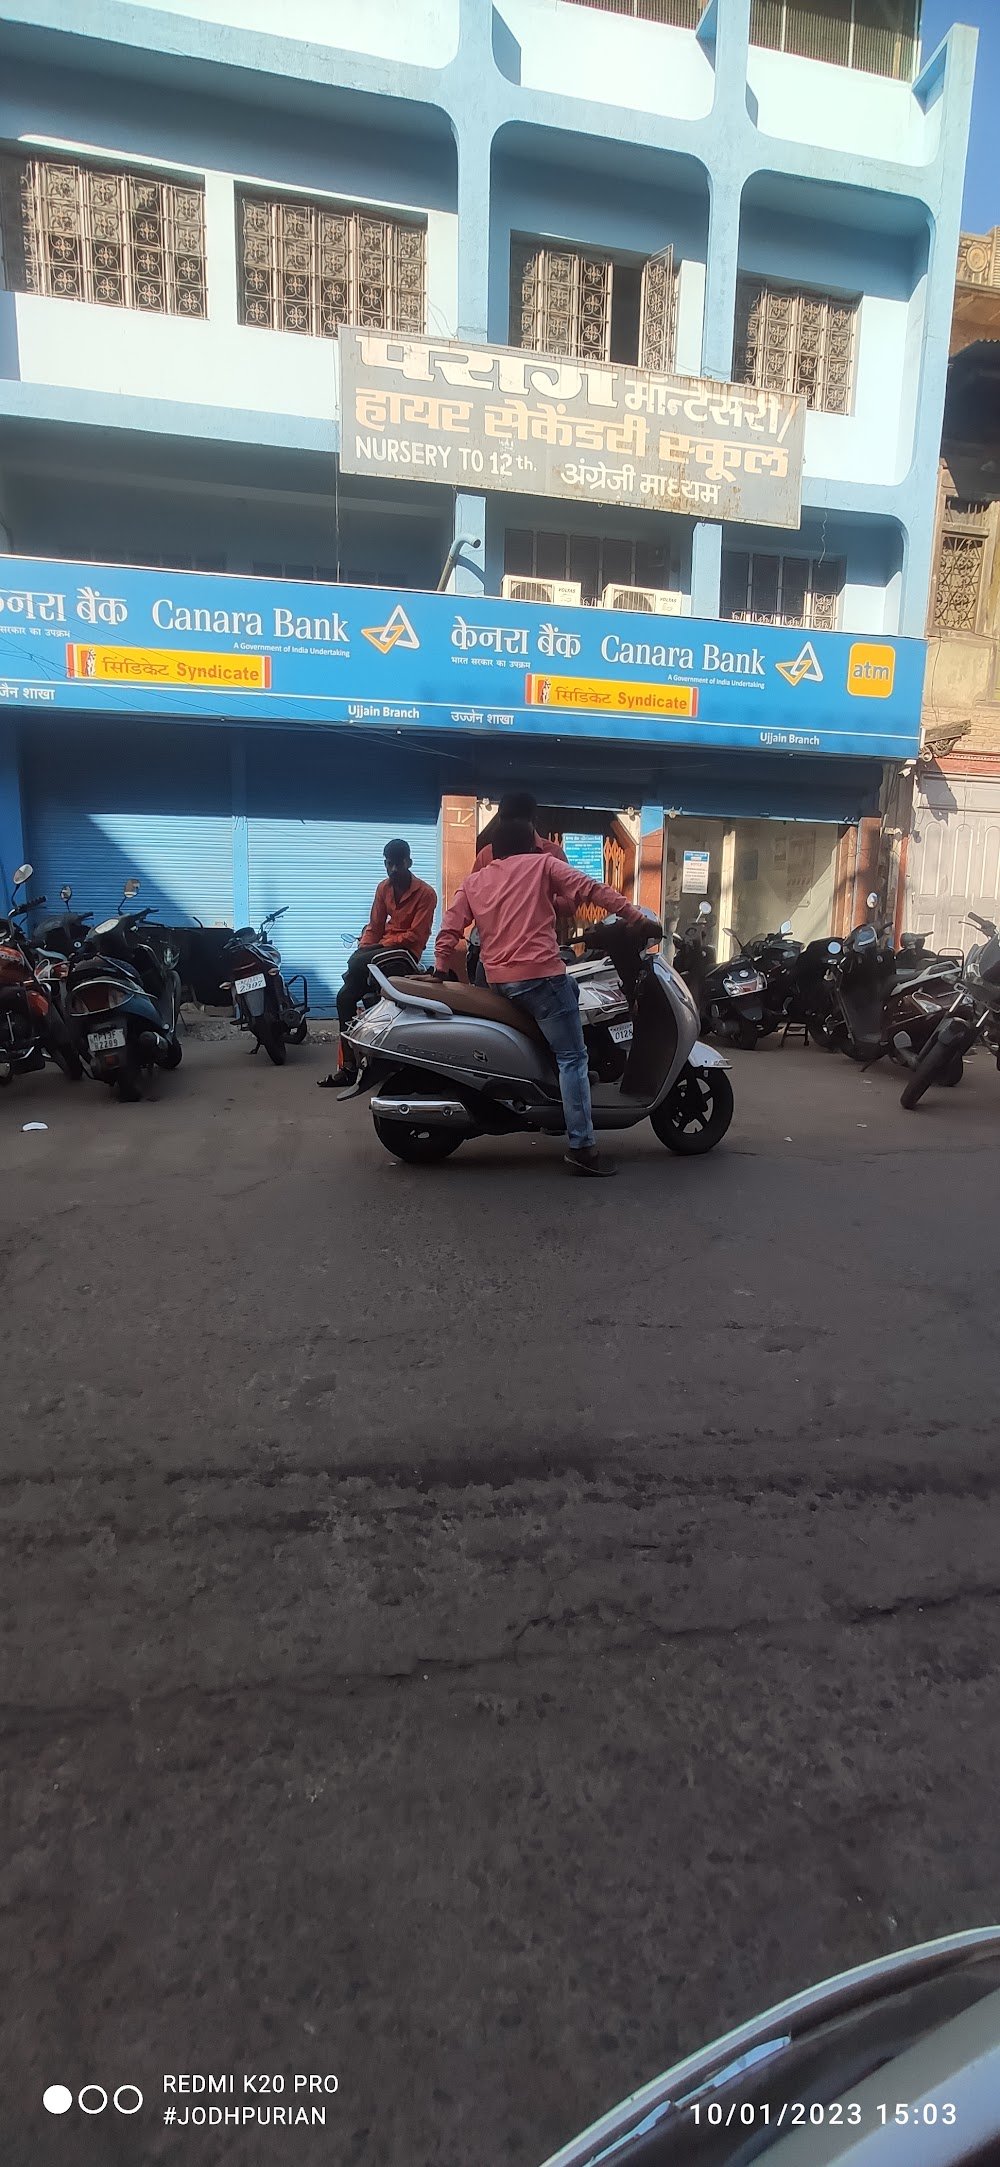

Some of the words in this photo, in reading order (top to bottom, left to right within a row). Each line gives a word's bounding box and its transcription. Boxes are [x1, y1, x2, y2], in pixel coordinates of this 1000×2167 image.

[355, 335, 618, 408] पराग
[355, 388, 473, 432] हायर
[484, 398, 650, 457] सेकेंडरी
[659, 430, 789, 483] स्कूल
[355, 435, 452, 469] NURSERY
[458, 447, 484, 474] TO
[560, 457, 636, 493] अंग्रेजी
[640, 472, 721, 505] माध्यम
[0, 588, 67, 622] नरा
[76, 586, 128, 625] बैंक
[152, 599, 263, 637] Canara
[273, 608, 350, 643] Bank
[451, 616, 530, 655] केनरा
[537, 623, 581, 658] बैंक
[240, 643, 282, 653] Government
[292, 646, 309, 654] India
[310, 648, 350, 658] Undertaking
[601, 635, 693, 669] Canara
[702, 643, 766, 676] Bank
[102, 656, 170, 676] सिंडिकेट
[177, 661, 259, 682] Syndicate
[450, 656, 469, 666] भारत
[471, 657, 494, 667] सरकार
[496, 659, 506, 668] का
[852, 660, 889, 681] atm
[673, 675, 708, 685] Government
[716, 678, 730, 686] India
[731, 679, 765, 690] Undertaking
[23, 687, 55, 701] शाखा
[555, 686, 612, 704] सिंडिकेट
[617, 691, 688, 710] Syndicate
[348, 704, 381, 718] Ujjain
[382, 706, 420, 719] Branch
[486, 713, 514, 725] शाखा
[760, 731, 787, 745] Ujjain
[789, 733, 820, 746] Branch
